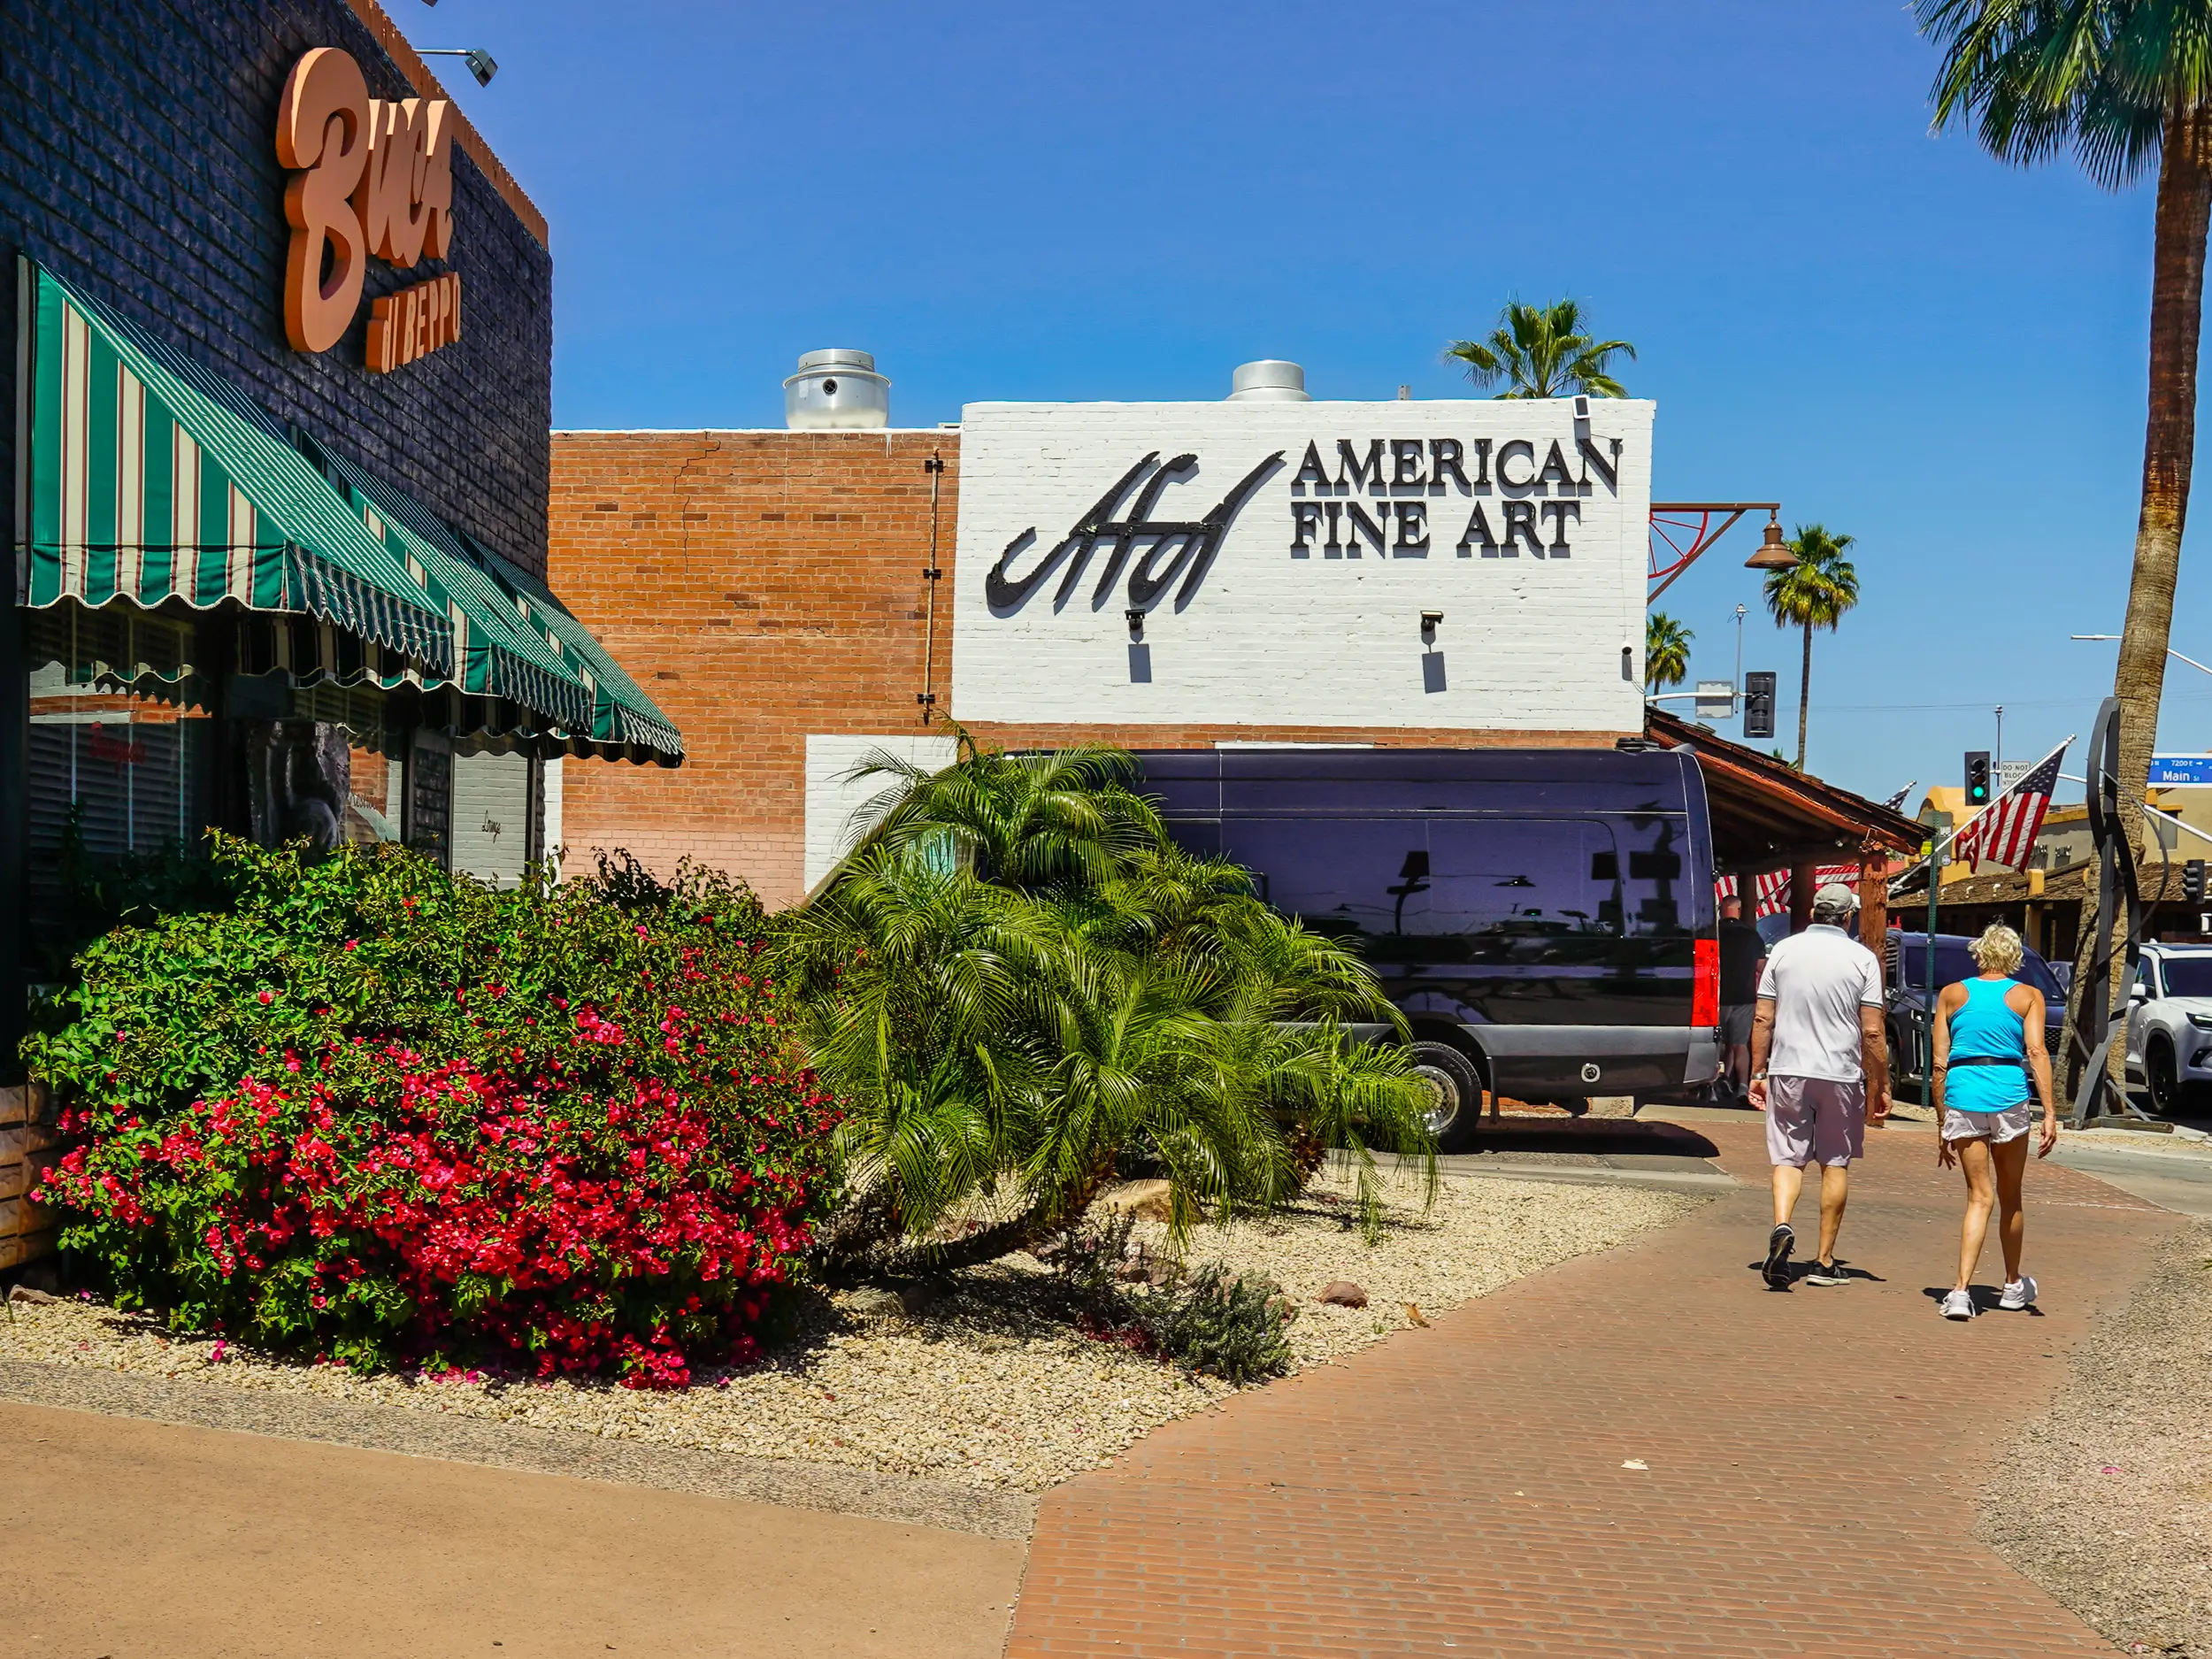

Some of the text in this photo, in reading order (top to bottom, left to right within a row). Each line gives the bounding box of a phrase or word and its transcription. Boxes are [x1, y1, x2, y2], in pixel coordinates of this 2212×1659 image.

[396, 272, 461, 365] BEPPO
[1290, 437, 1624, 498] AMERICAN
[1289, 499, 1582, 558] FINE ART
[2162, 770, 2191, 781] Main
